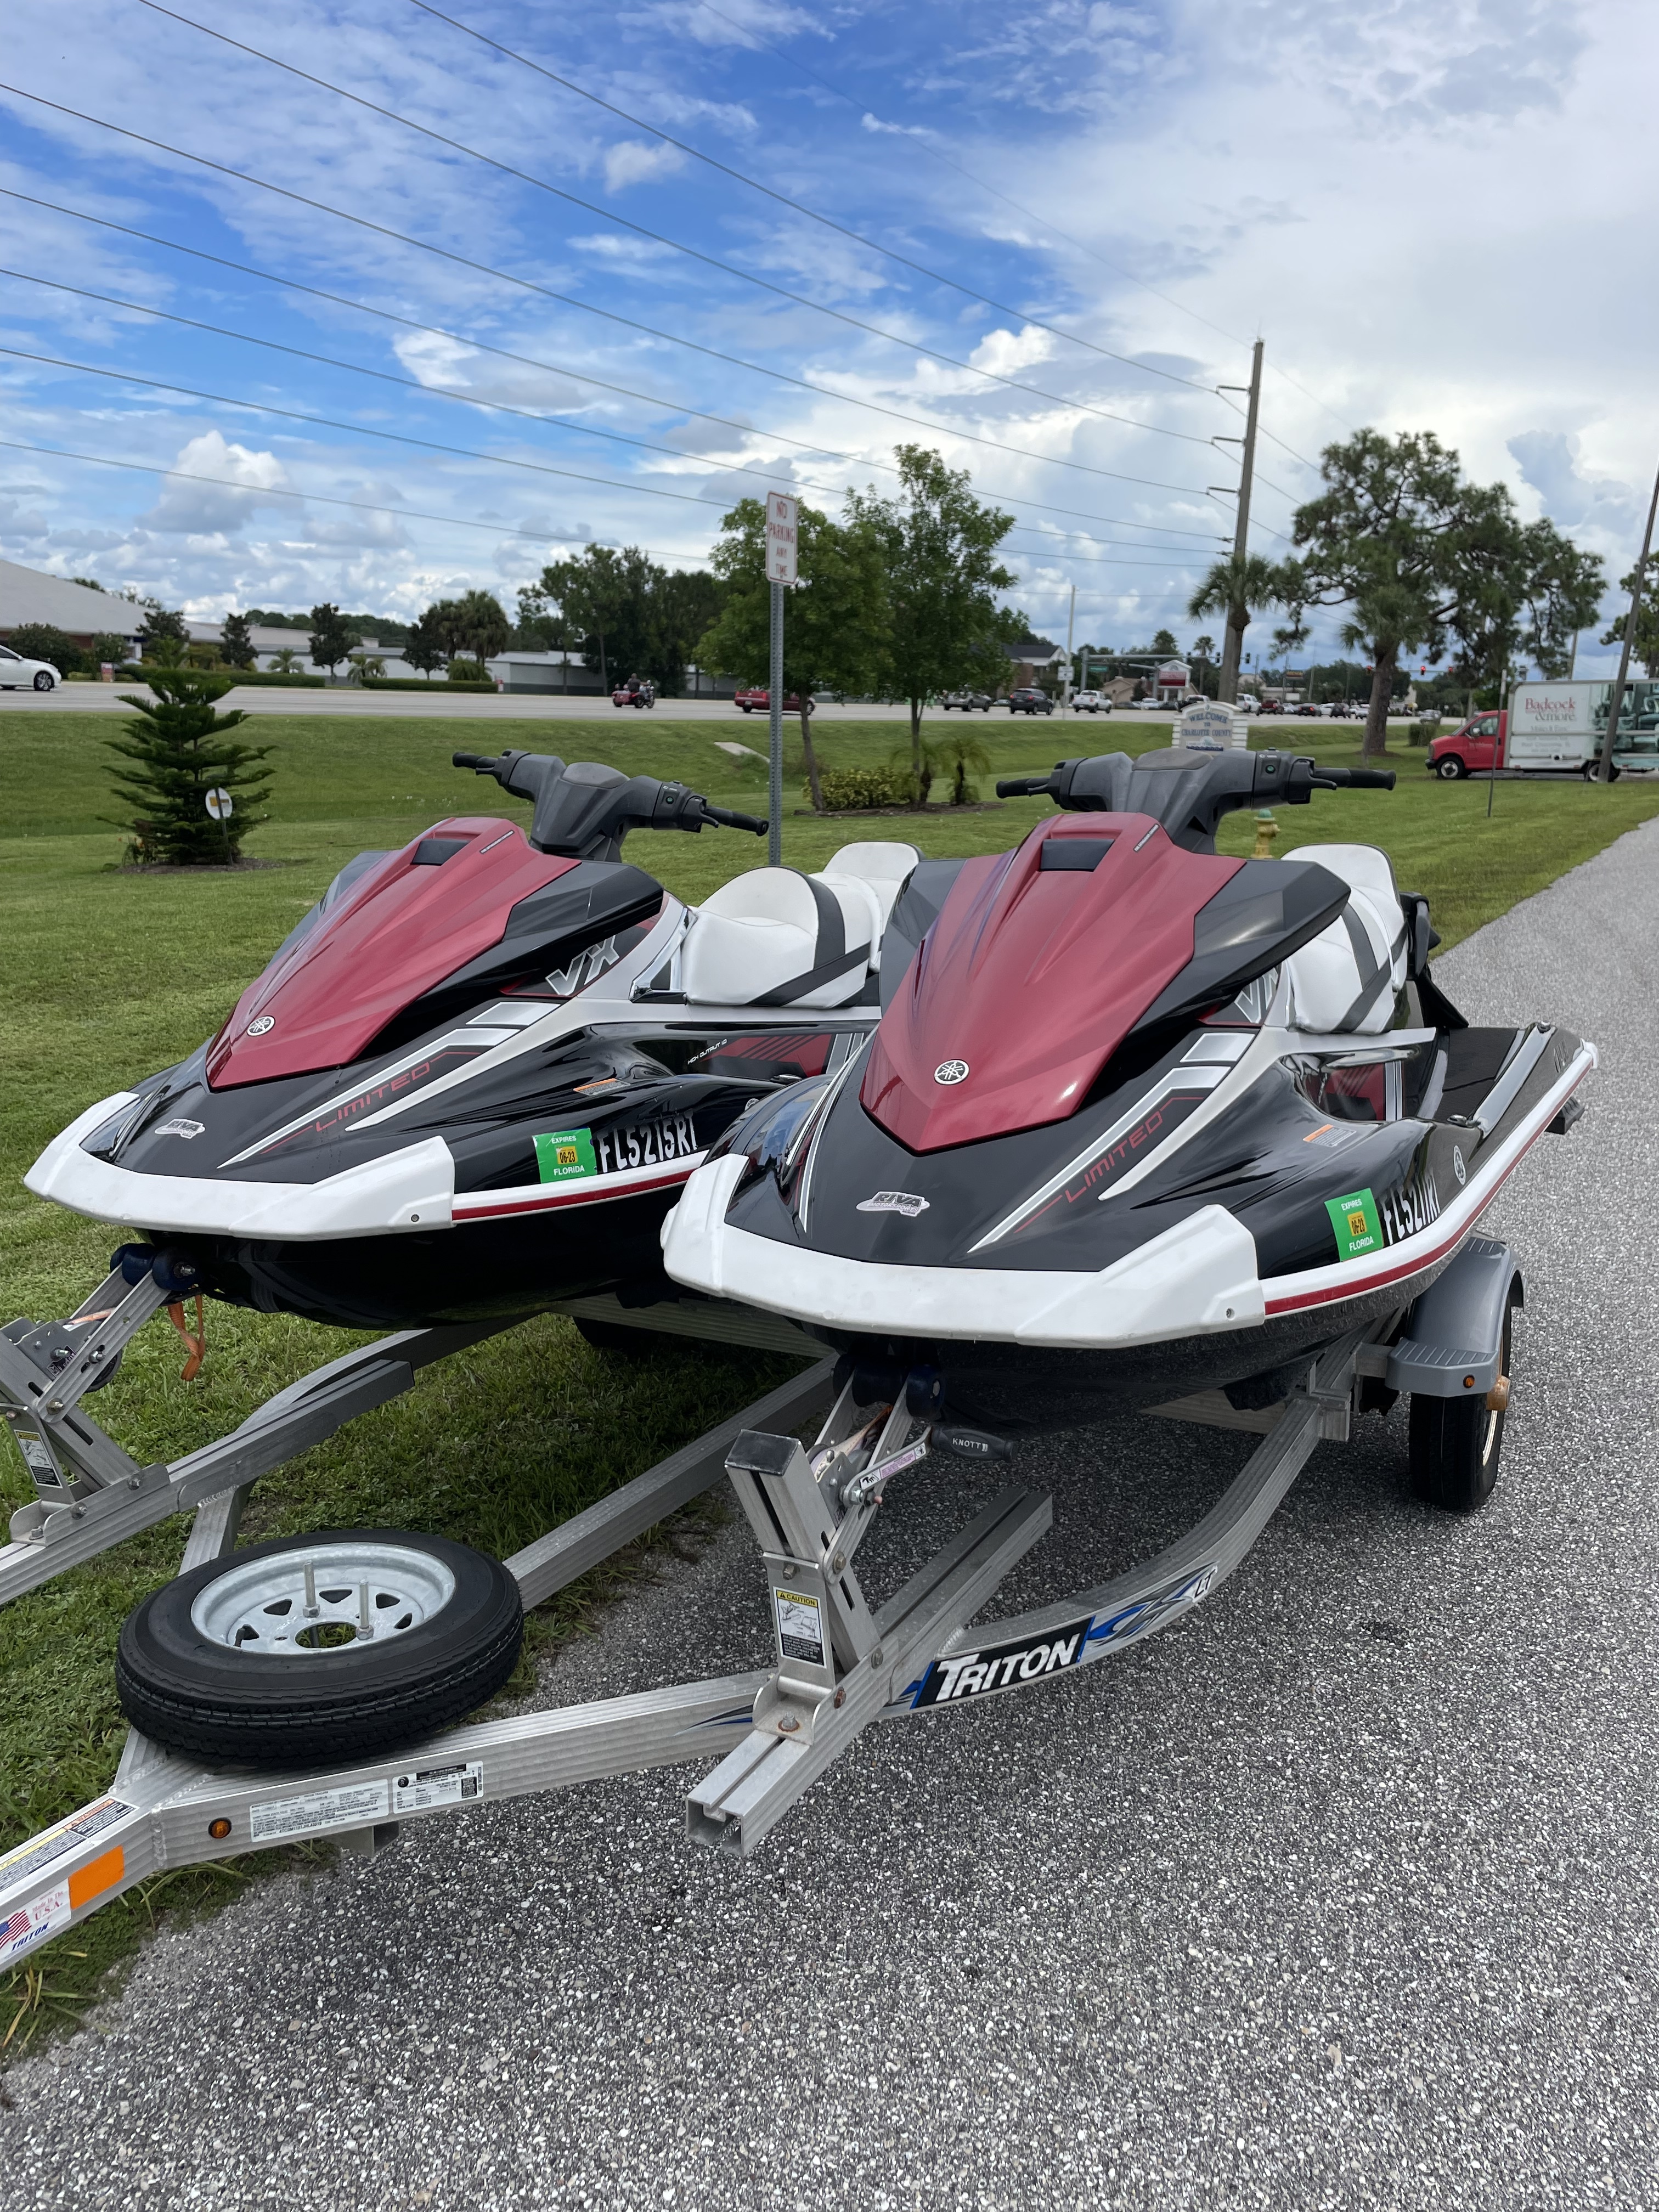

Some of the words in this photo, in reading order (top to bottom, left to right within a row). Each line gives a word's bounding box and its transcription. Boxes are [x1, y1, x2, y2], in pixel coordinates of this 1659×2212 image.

[776, 500, 788, 519] NO
[769, 522, 795, 543] PARKING
[776, 546, 787, 558] ANY
[776, 563, 787, 576] TIME
[1525, 697, 1575, 709] Badcock
[1189, 712, 1228, 724] WELCOME
[1535, 712, 1575, 721] &more
[545, 935, 619, 996] VX
[699, 1042, 721, 1058] OUTPUT
[315, 1062, 430, 1132] LIMITED
[166, 1120, 201, 1131] RIVA
[551, 1135, 577, 1144] EXPIRES
[560, 1150, 575, 1164] 06-23
[1065, 1110, 1163, 1203] LIMITED
[554, 1165, 585, 1176] FLORIDA
[867, 1202, 919, 1212] MOTORSPORTS
[873, 1193, 922, 1207] RIVA
[1341, 1199, 1362, 1211] EXPIRES
[1351, 1217, 1365, 1234] 06-23
[1349, 1235, 1374, 1251] FLORIDA
[952, 1437, 981, 1449] KNOTT
[1194, 1569, 1216, 1598] LT
[787, 1594, 815, 1605] CAUTION
[935, 1633, 1081, 1702] TRITON
[54, 1891, 63, 1899] The
[35, 1901, 63, 1921] U.S.A.
[12, 1922, 49, 1951] TRITON
